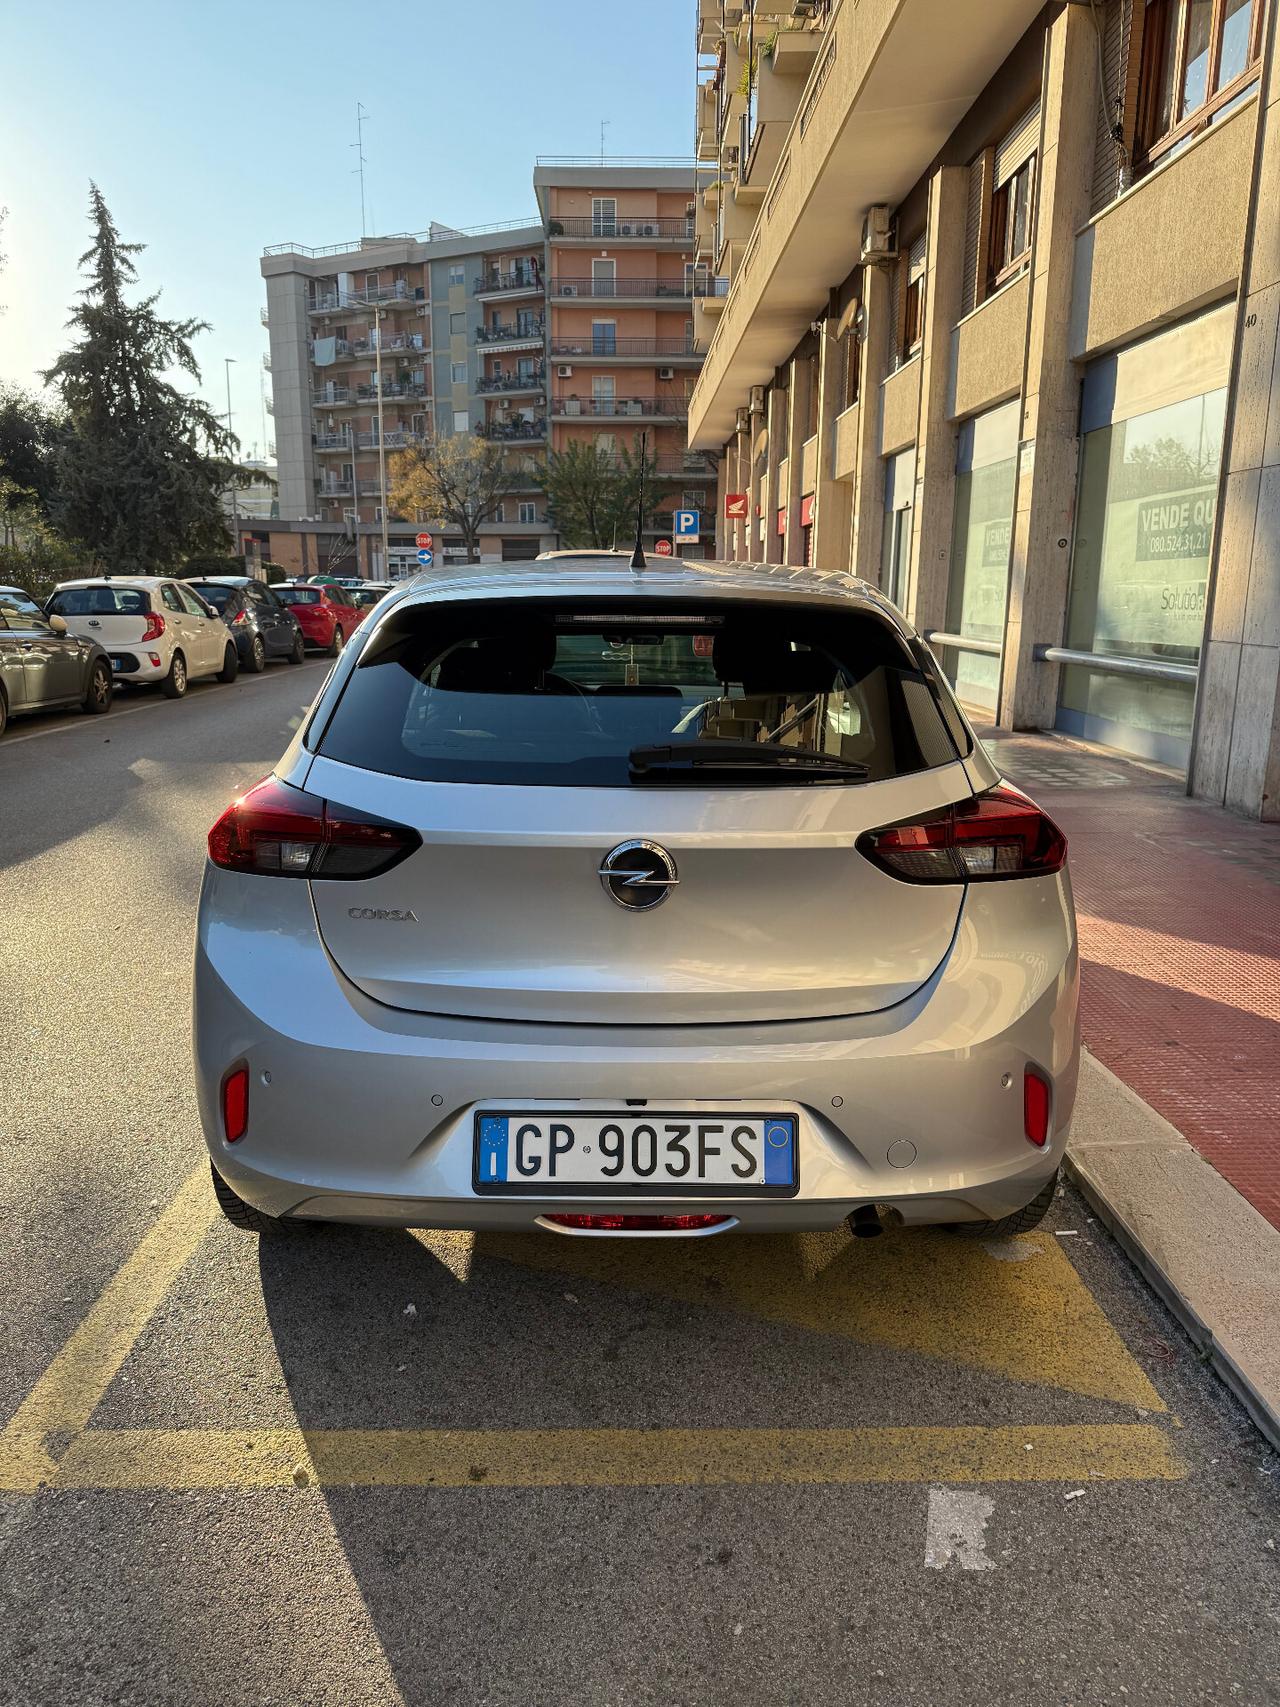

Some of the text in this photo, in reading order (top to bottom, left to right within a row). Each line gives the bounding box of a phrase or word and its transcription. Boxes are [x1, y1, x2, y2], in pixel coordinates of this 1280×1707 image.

[680, 513, 694, 532] P
[1142, 502, 1190, 531] VENDE
[656, 545, 671, 553] STOP
[348, 907, 419, 922] CORSA
[515, 1124, 757, 1178] GP 903FS
